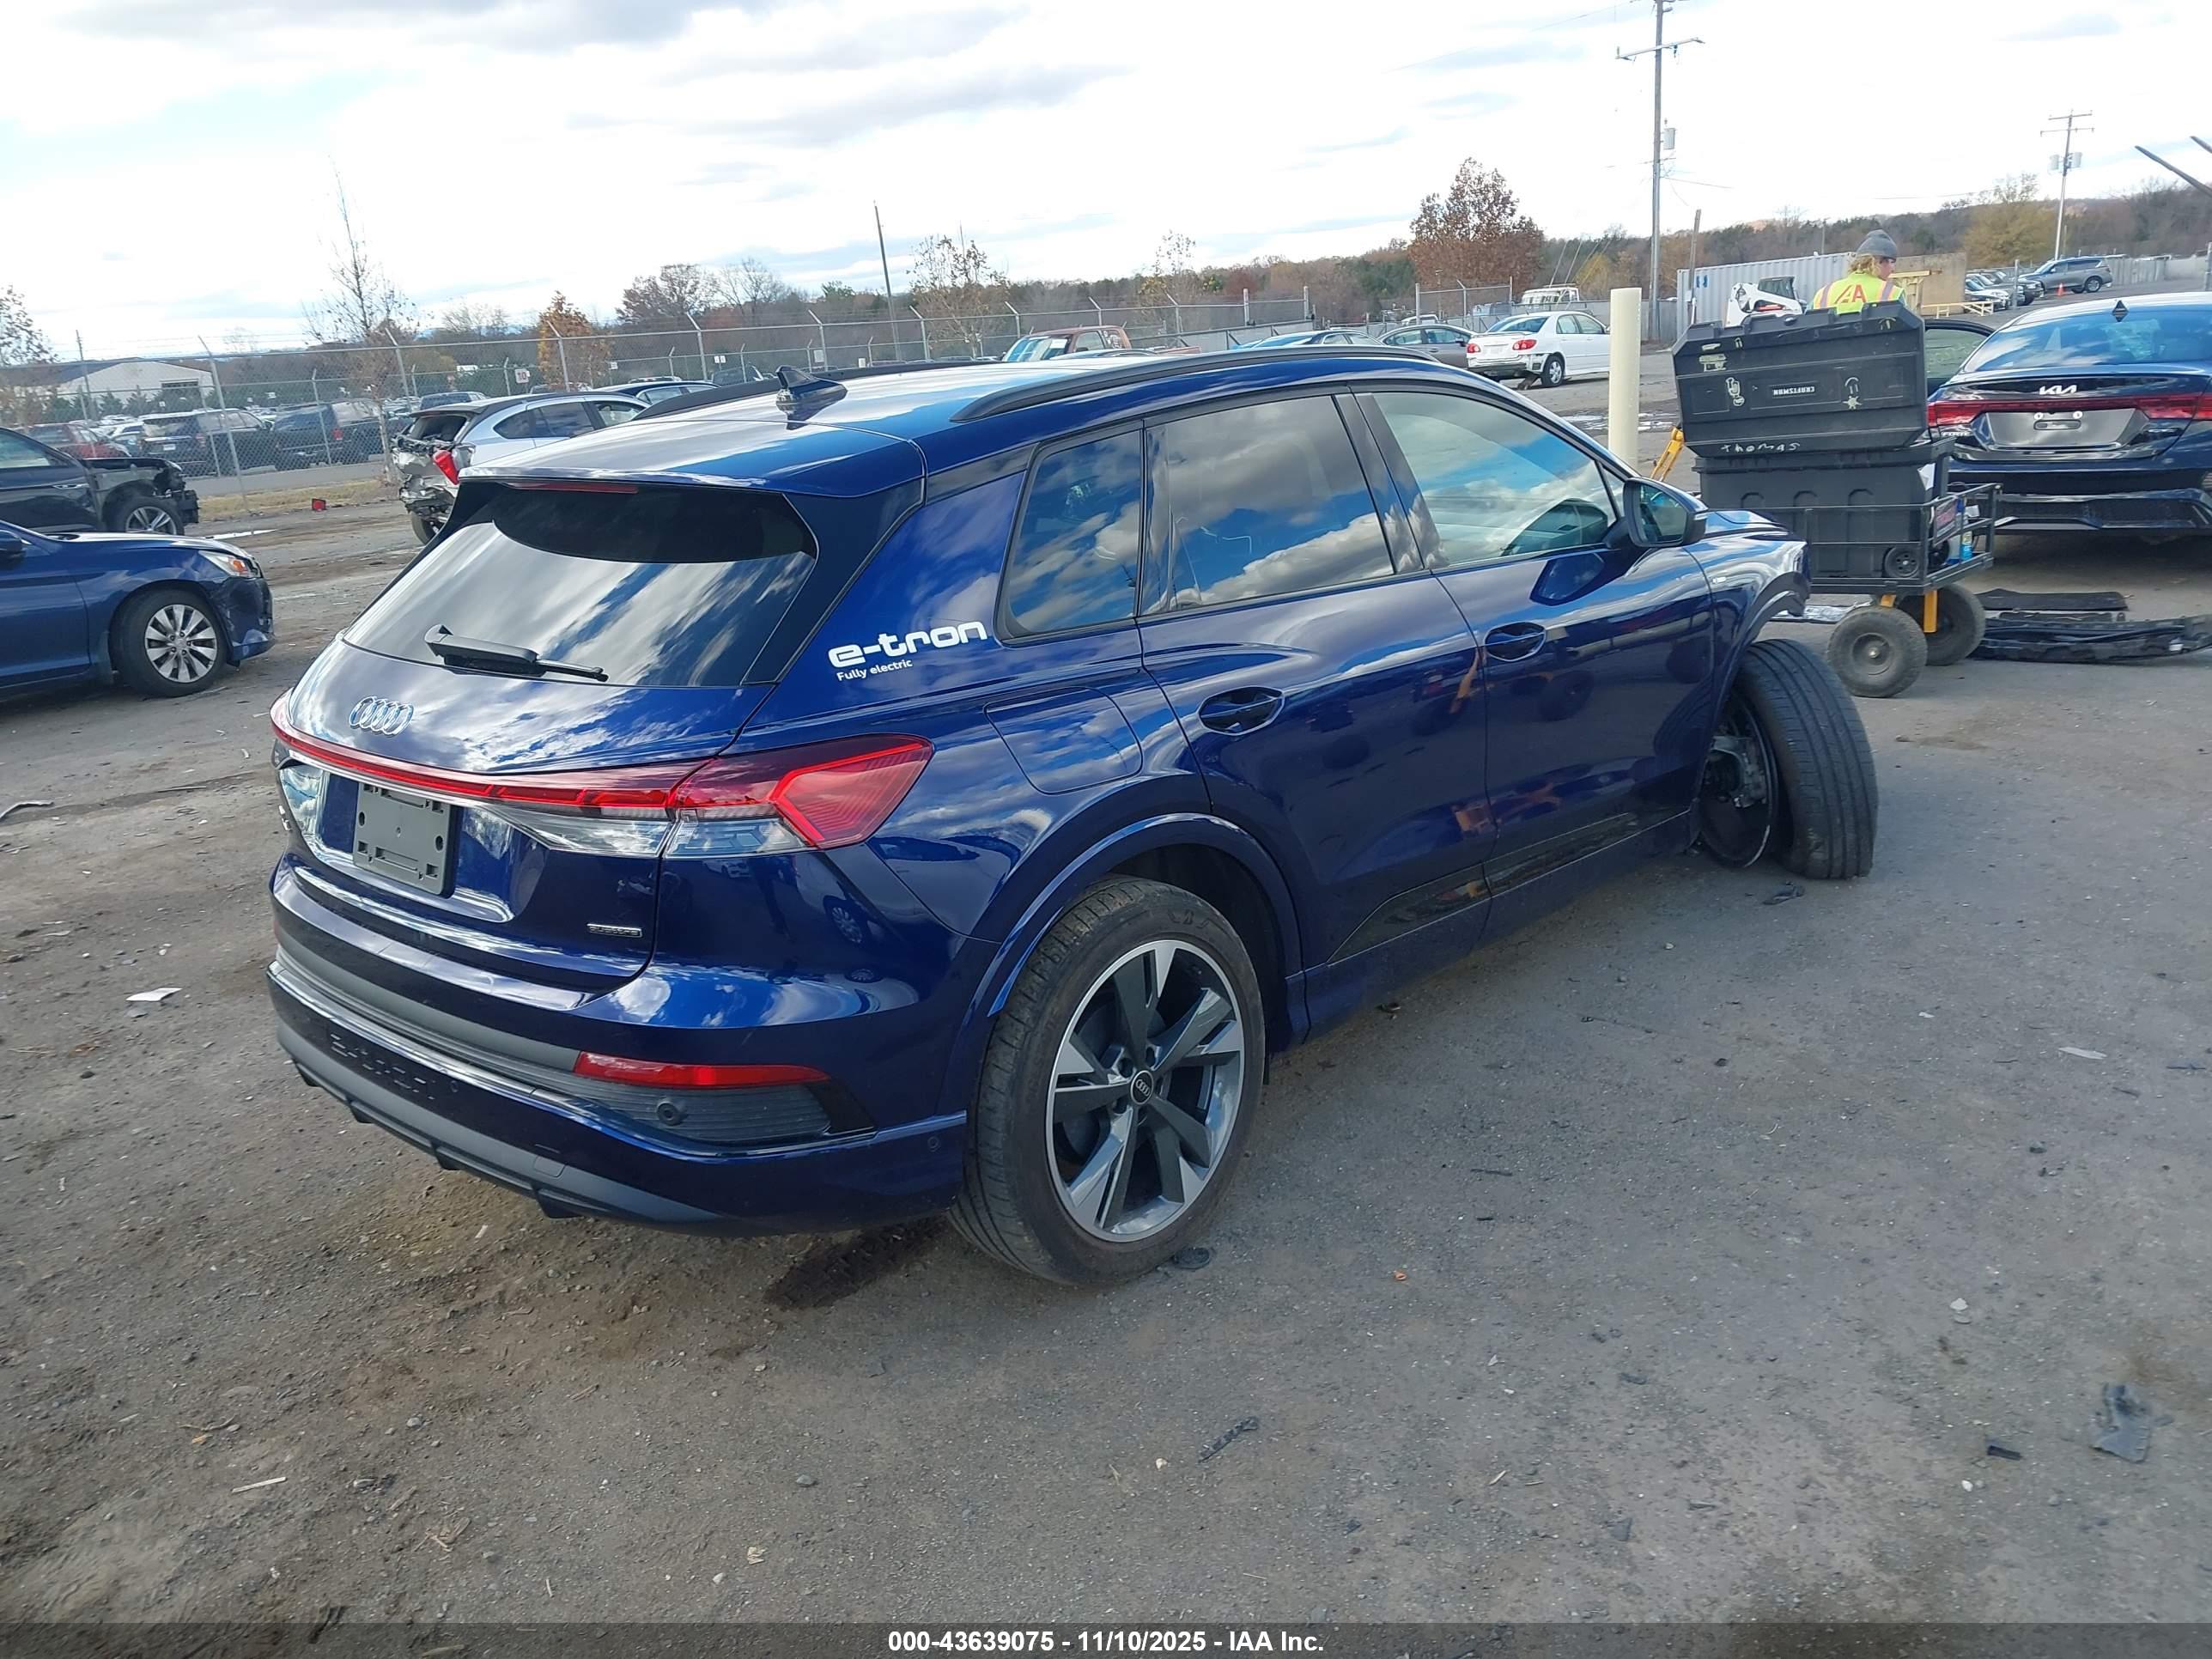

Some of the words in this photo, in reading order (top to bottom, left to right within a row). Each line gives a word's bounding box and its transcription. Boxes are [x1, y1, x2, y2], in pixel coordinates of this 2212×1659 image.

[1772, 386, 1815, 396] CRAFTSMAN
[2039, 384, 2077, 395] KIA
[828, 621, 988, 667] e-tron
[836, 668, 867, 682] Fully
[870, 659, 914, 675] electric
